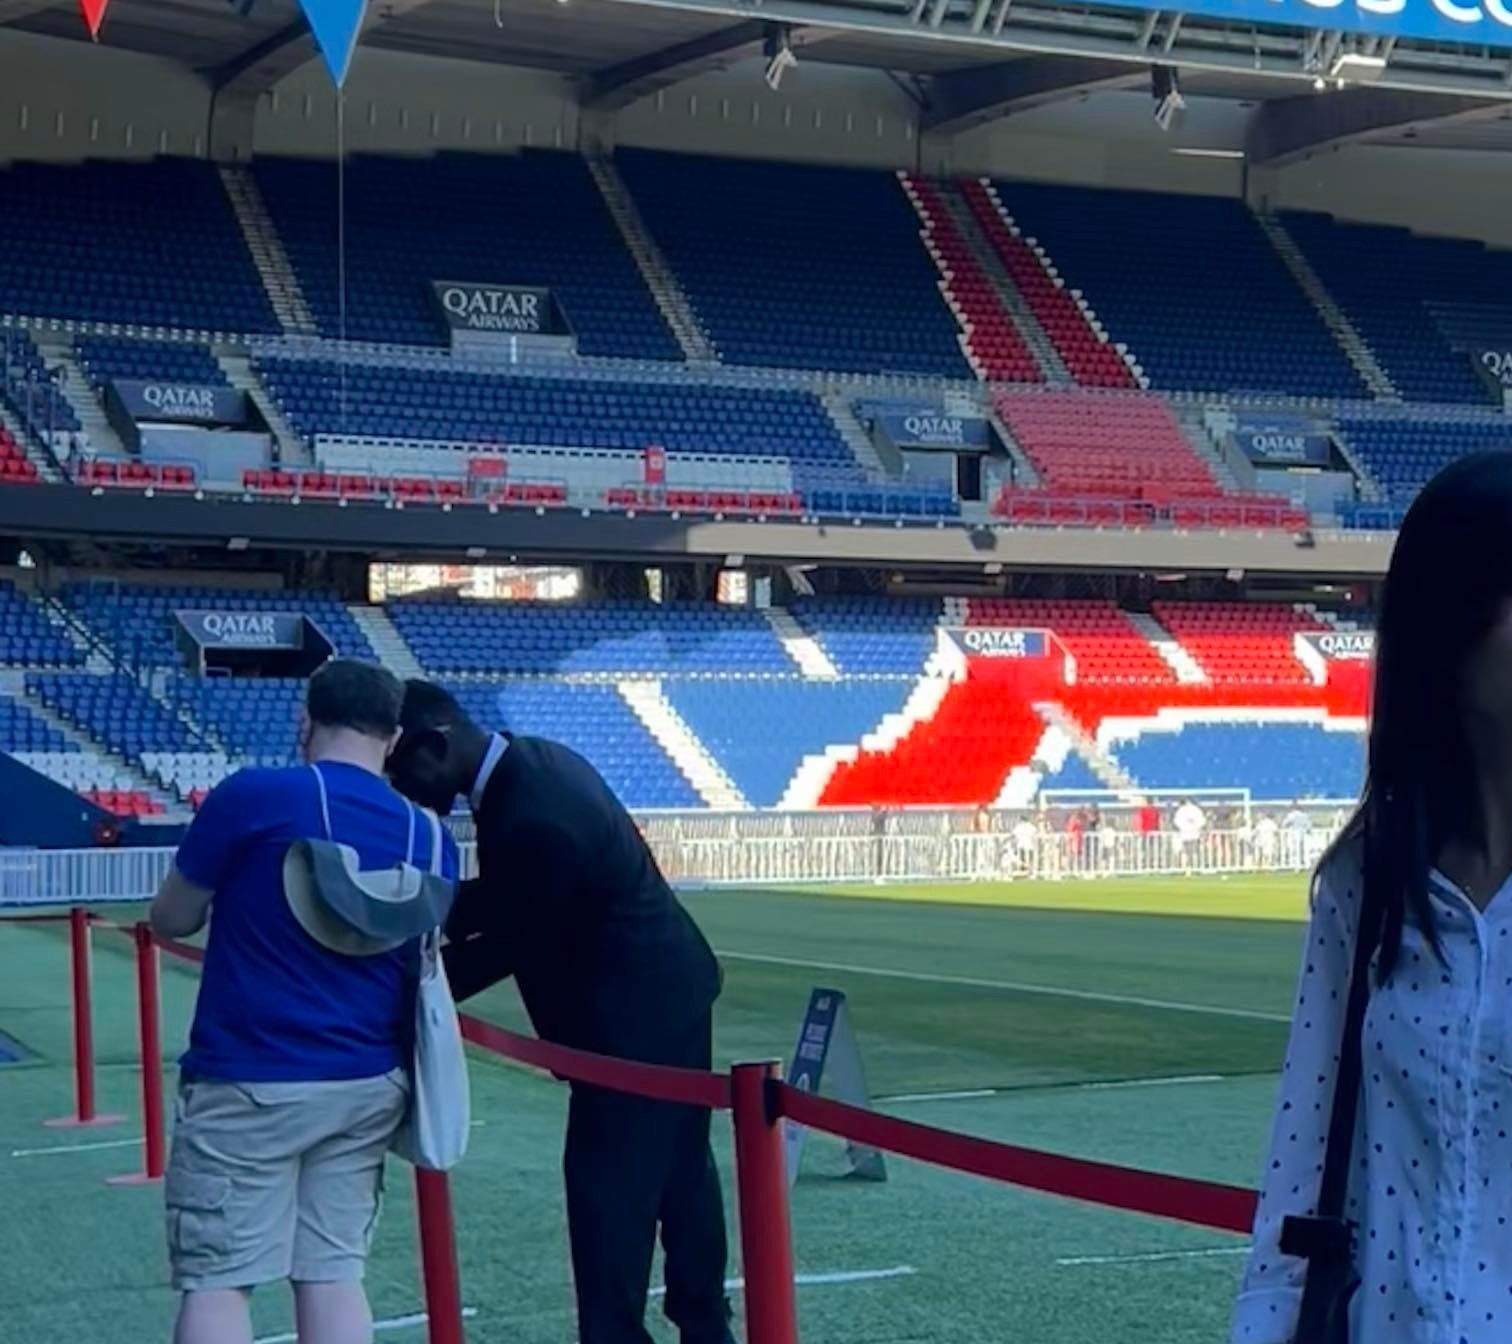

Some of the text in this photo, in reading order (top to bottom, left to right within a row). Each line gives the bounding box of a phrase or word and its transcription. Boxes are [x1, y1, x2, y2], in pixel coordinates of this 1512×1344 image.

[443, 288, 538, 317] QATAR
[468, 314, 539, 331] AIRWAYS
[144, 386, 214, 408] QATAR
[904, 417, 963, 436] QATAR
[1252, 435, 1305, 455] QATAR
[203, 615, 275, 637] QATAR
[964, 631, 1025, 651] QATAR
